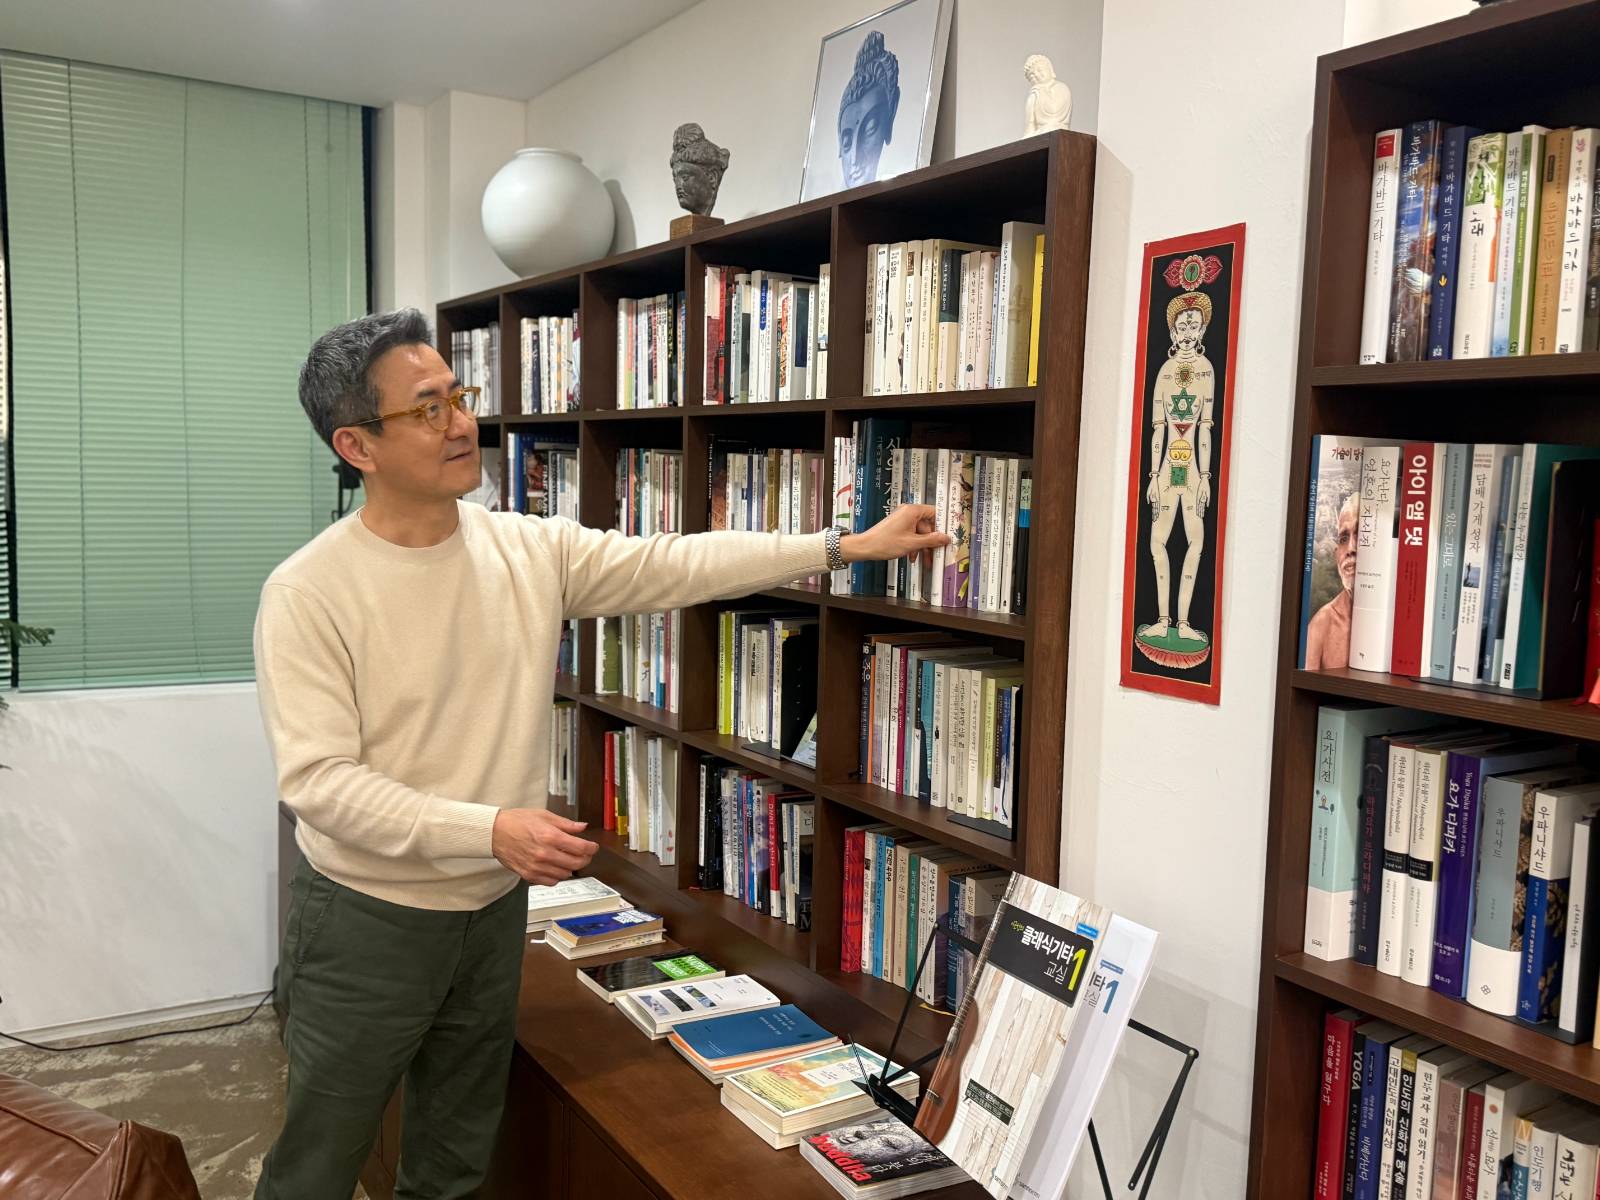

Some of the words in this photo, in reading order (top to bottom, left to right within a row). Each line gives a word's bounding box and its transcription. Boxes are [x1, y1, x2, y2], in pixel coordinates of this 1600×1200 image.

[1408, 136, 1421, 177] 바가바드
[1505, 146, 1519, 193] 바가바드
[1406, 180, 1418, 201] 기타
[1503, 197, 1516, 219] 기타
[1470, 210, 1485, 237] 노래
[1361, 458, 1377, 501] 영혼의
[1408, 454, 1428, 495] 아이
[1475, 473, 1488, 498] 담배
[1359, 504, 1373, 548] 자서전
[1406, 500, 1425, 521] 앰
[1472, 500, 1485, 526] 가게
[1519, 502, 1528, 521] 나는
[1404, 527, 1423, 546] 댓
[1469, 528, 1482, 553] 성자
[1514, 523, 1526, 562] 누구인가
[1321, 730, 1335, 783] 요가사전
[1446, 778, 1460, 809] 요가
[1462, 772, 1473, 787] Yoga
[1462, 788, 1472, 810] Dipika
[1443, 812, 1458, 854] 디피카
[1493, 807, 1506, 858] 우파니샤드
[1533, 806, 1551, 873] 우파니샤드
[1021, 925, 1074, 965] 클래식기타
[1068, 948, 1087, 991] 1
[1043, 961, 1069, 985] 교실
[1102, 980, 1119, 1015] 1
[1352, 1050, 1363, 1091] YOGA
[1399, 1073, 1414, 1115] 인도의
[1420, 1071, 1433, 1113] 힌두교사
[1383, 1107, 1395, 1150] 신비사상
[1396, 1116, 1412, 1157] 신화와
[807, 1133, 872, 1182] buddha
[1359, 1136, 1372, 1181] 비베카난다
[1394, 1158, 1407, 1186] 예술
[1483, 1152, 1496, 1176] 요가
[1530, 1144, 1545, 1193] 인도기행
